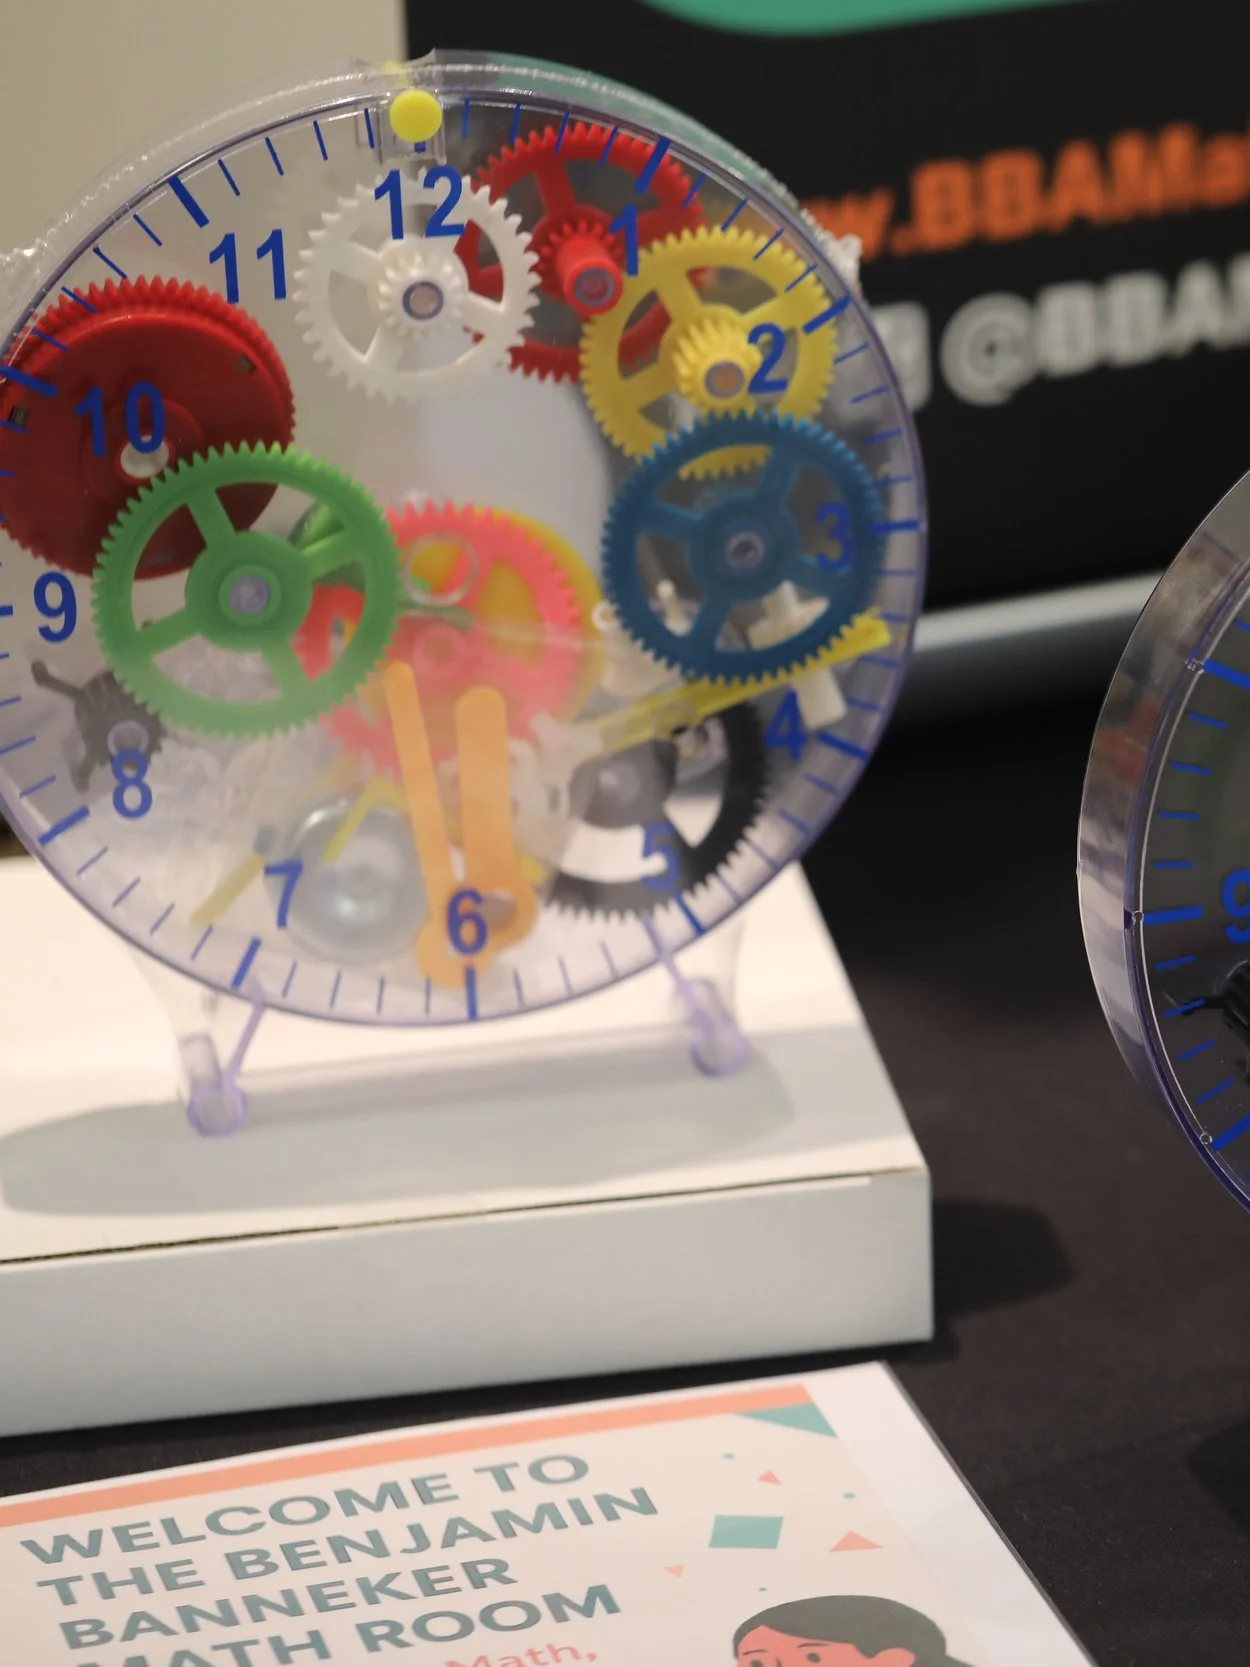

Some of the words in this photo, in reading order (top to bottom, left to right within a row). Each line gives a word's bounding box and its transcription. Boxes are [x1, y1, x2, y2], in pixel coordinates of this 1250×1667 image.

[375, 166, 465, 240] 12
[209, 229, 288, 304] 11
[609, 204, 640, 276] 1
[747, 322, 788, 394] 2
[75, 382, 167, 458] 10
[815, 503, 854, 571] 3
[33, 571, 77, 643] 9
[765, 689, 803, 758] 4
[112, 749, 152, 818] 8
[640, 822, 680, 891] 5
[263, 861, 304, 929] 7
[446, 889, 487, 956] 6
[20, 1473, 460, 1565] WELCOME
[473, 1454, 590, 1493] TO
[37, 1557, 206, 1606] THE
[224, 1486, 659, 1582] BENJAMIN
[58, 1557, 519, 1650] BANNEKER
[77, 1629, 332, 1667] ATH
[355, 1584, 622, 1654] ROOM
